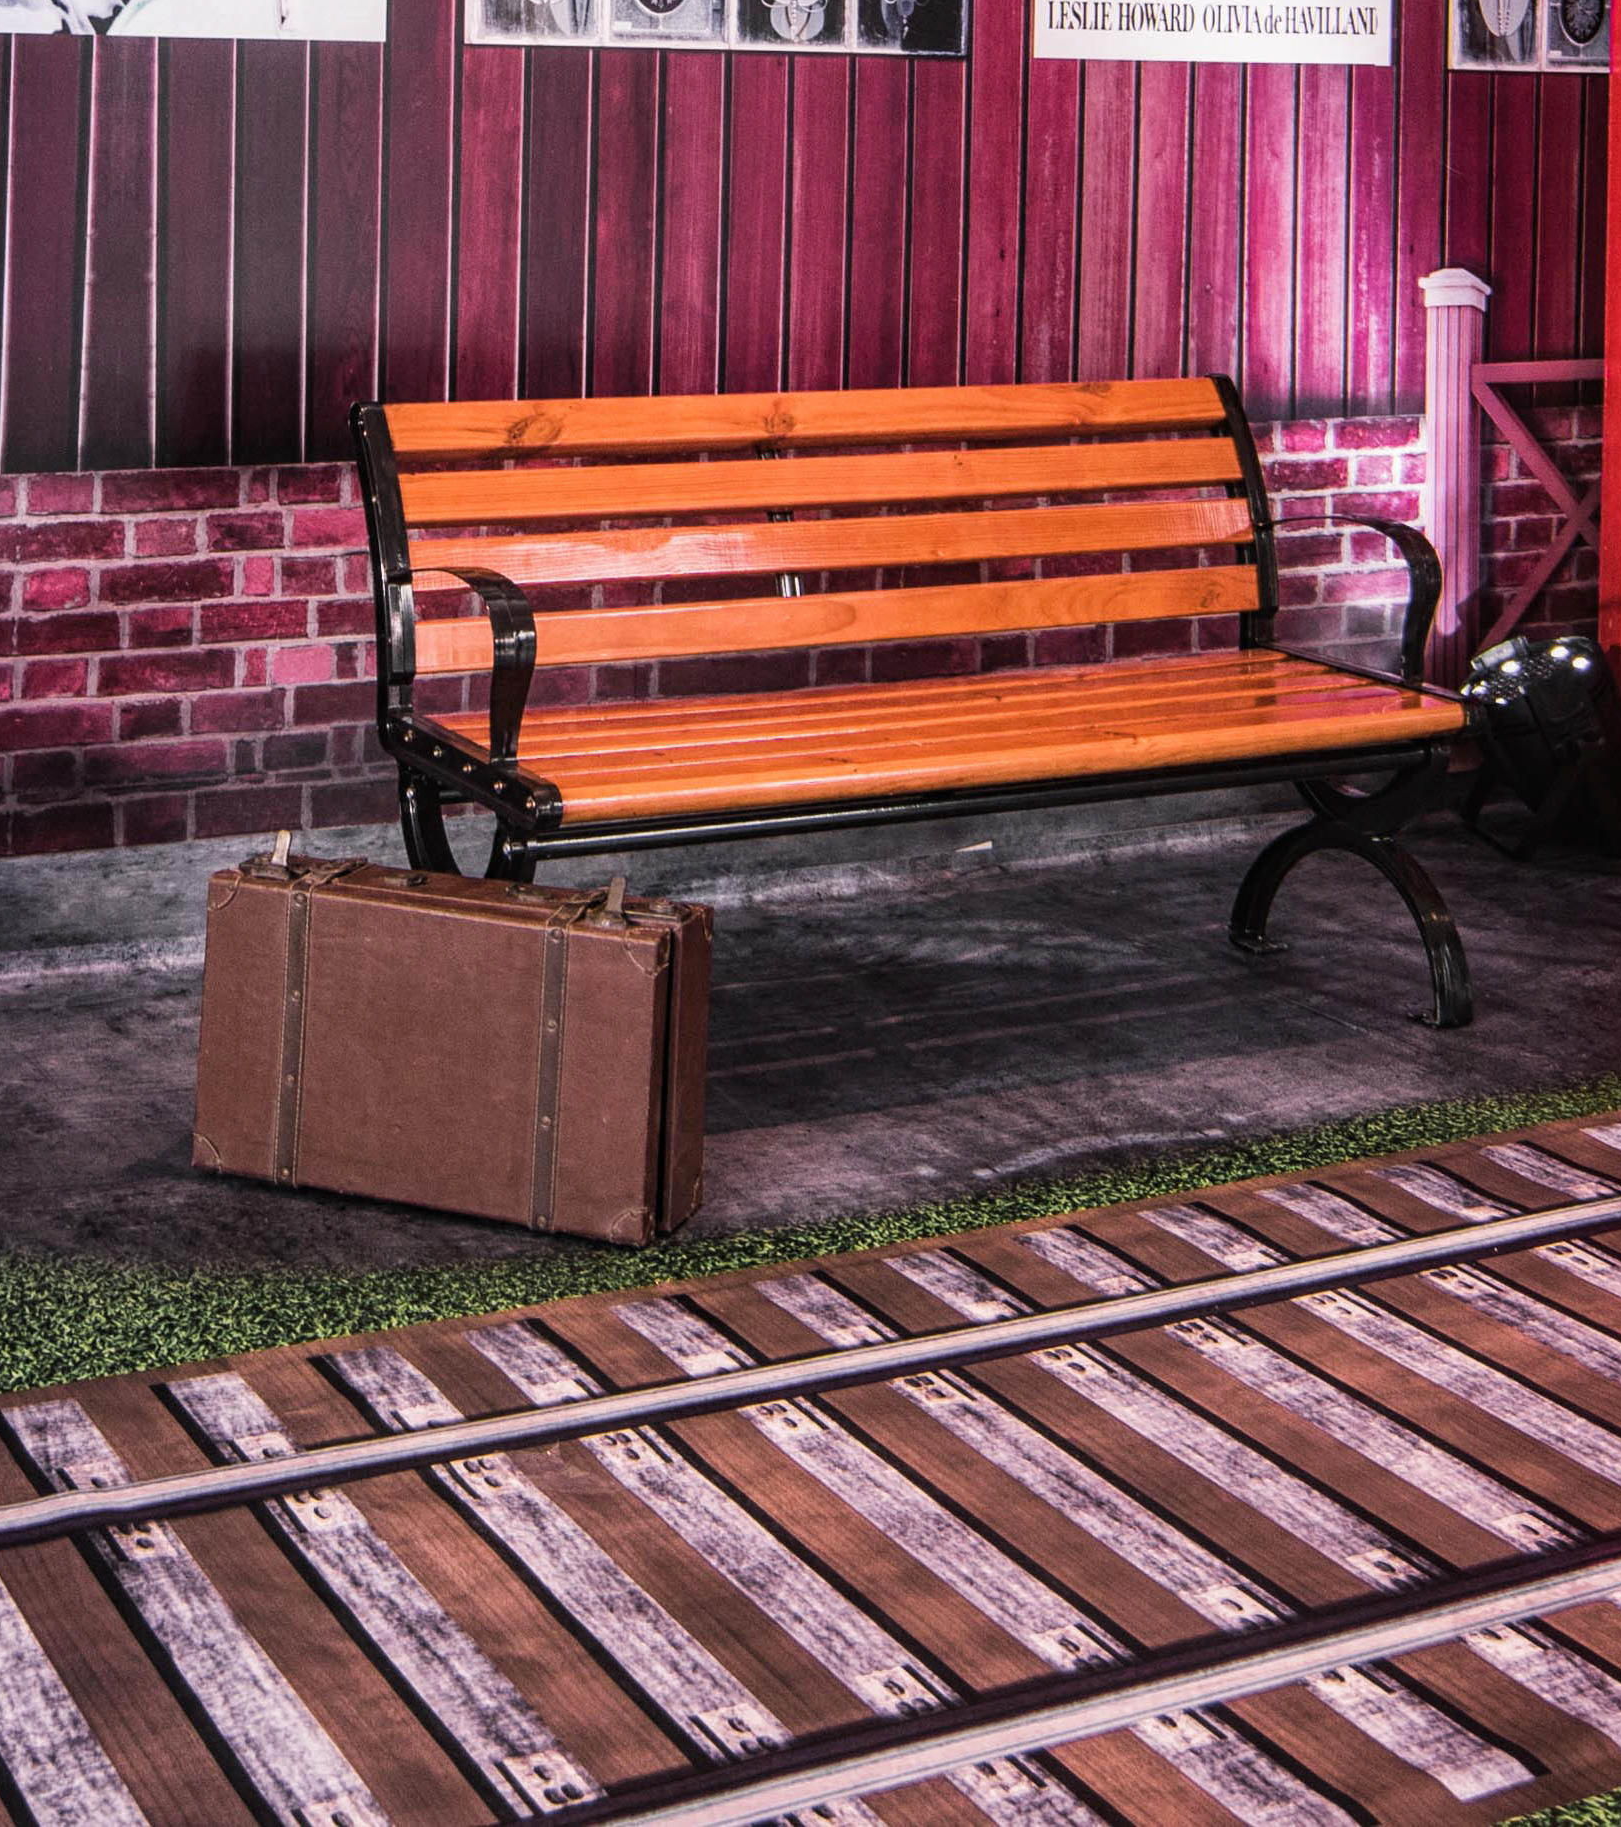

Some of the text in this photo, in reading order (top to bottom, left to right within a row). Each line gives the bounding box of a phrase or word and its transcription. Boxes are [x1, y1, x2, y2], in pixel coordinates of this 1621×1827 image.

[1047, 0, 1379, 36] LESLIE HOWARD OLIVIA de HAVILLAND
